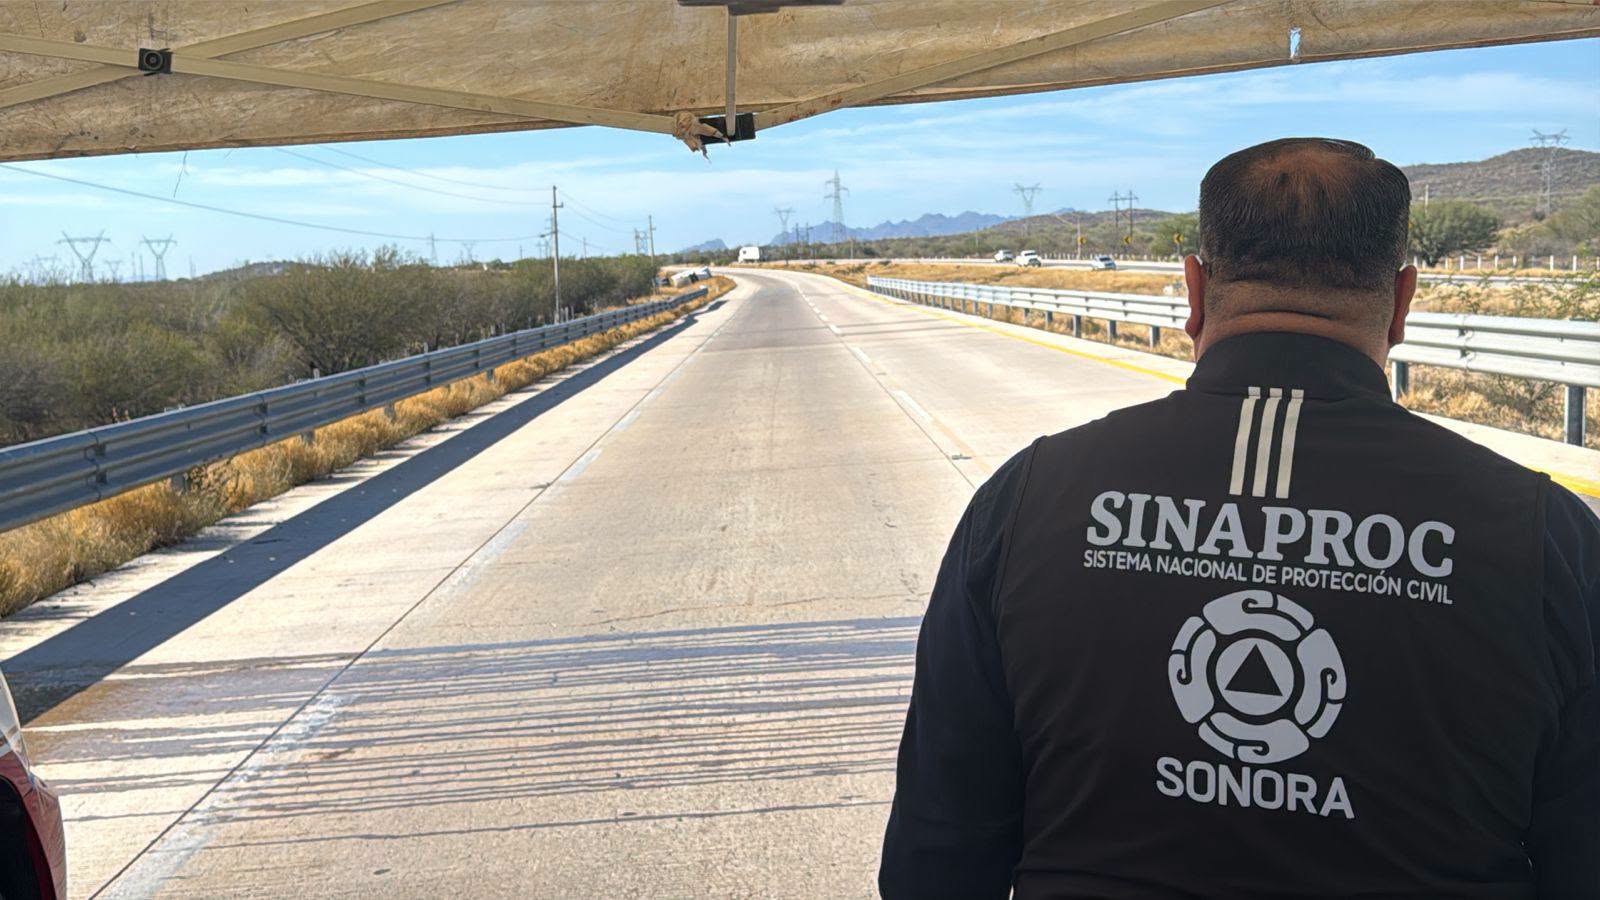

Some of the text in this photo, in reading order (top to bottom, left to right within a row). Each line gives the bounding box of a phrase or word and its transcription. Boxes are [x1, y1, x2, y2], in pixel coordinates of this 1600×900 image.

[1086, 490, 1456, 578] SINAPROC
[1083, 549, 1453, 605] SISTEMA NACIONAL DE PROTECCIÓN CIVIL
[1156, 756, 1355, 819] SONORA
